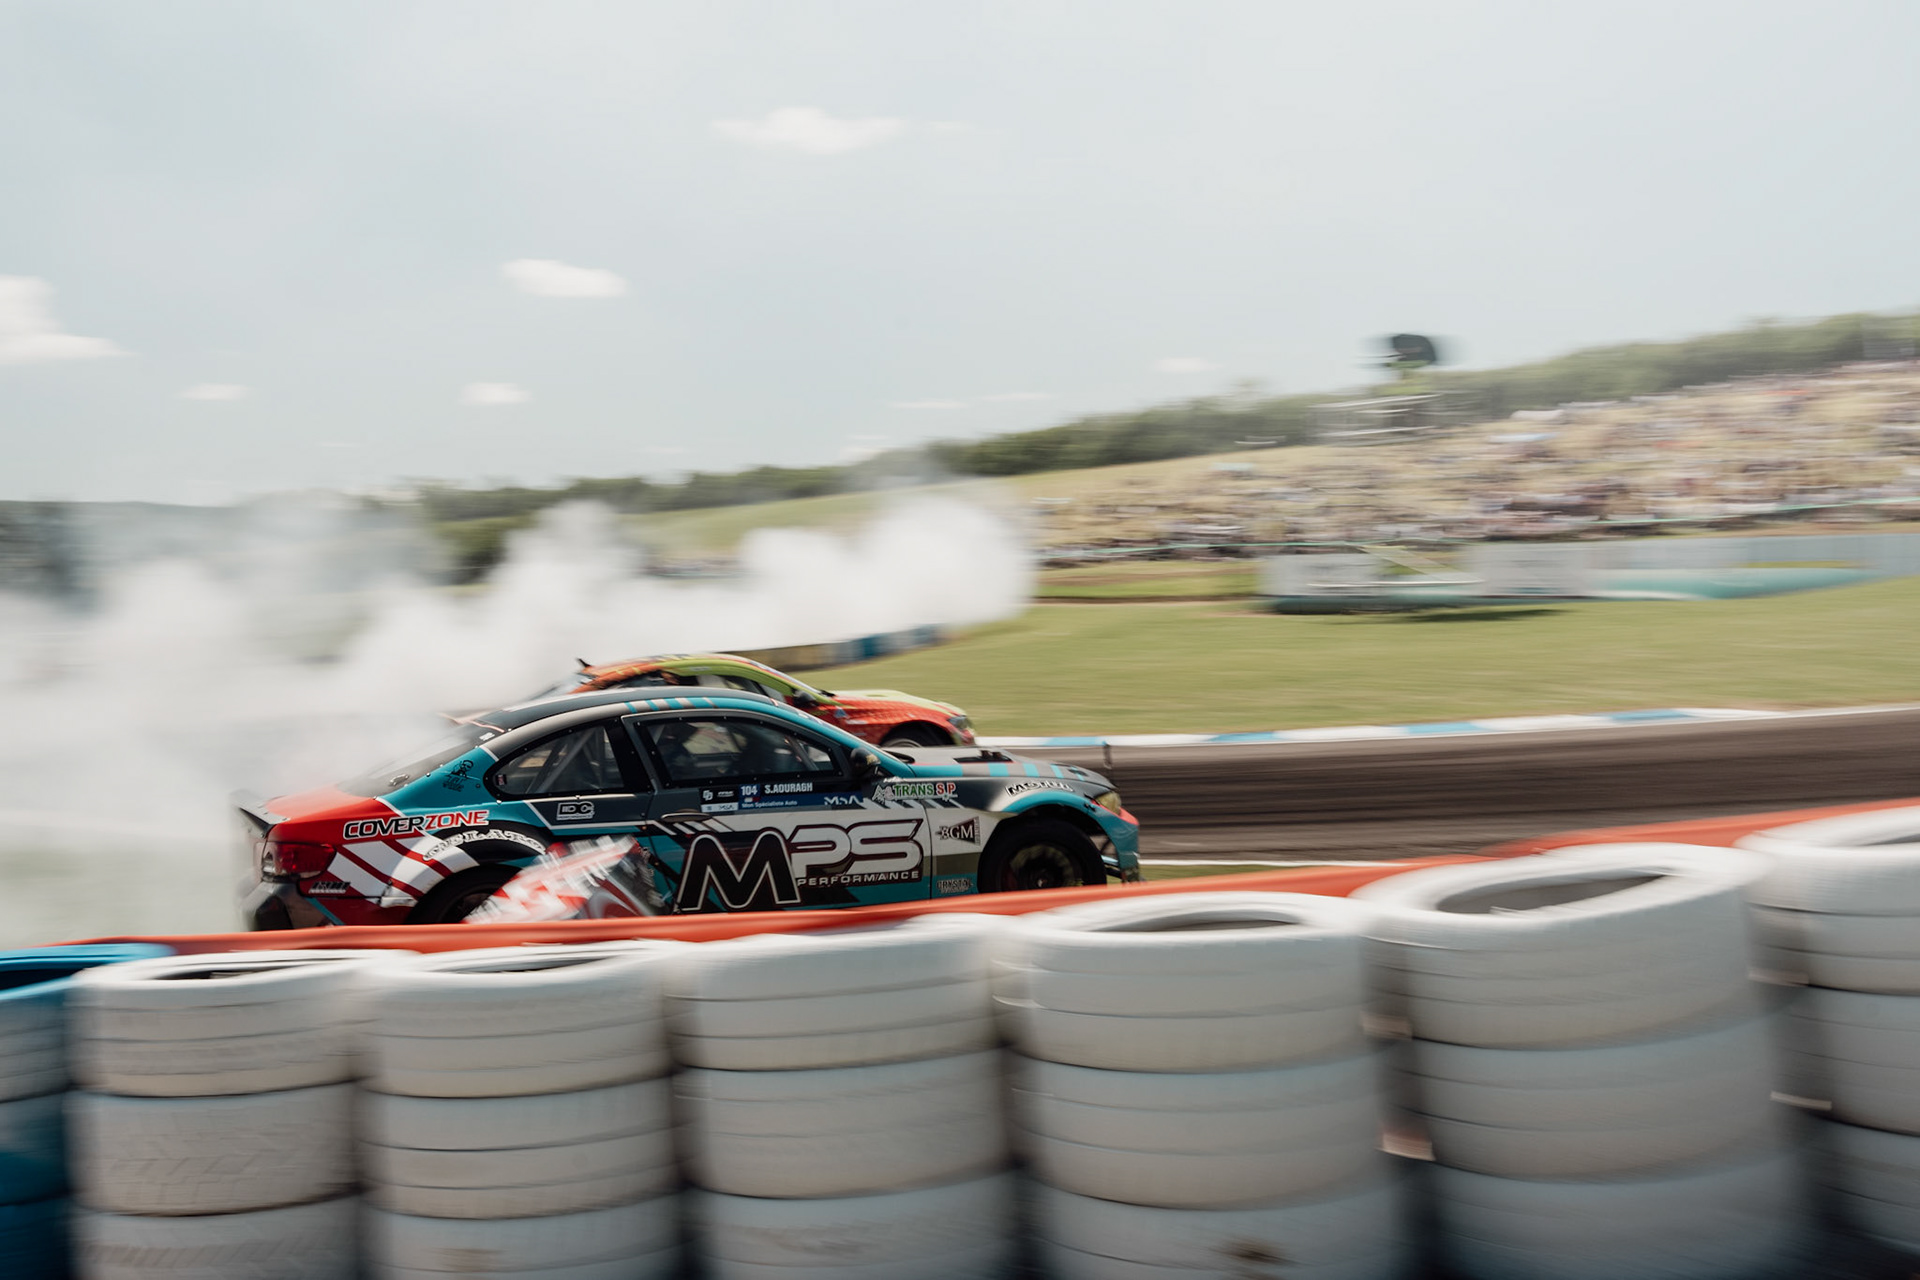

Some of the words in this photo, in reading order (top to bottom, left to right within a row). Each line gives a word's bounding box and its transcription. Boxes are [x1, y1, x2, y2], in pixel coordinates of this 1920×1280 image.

[741, 785, 758, 797] 104
[894, 783, 935, 797] TRANS
[343, 810, 489, 839] COVERZONE
[674, 818, 924, 912] MPS
[797, 870, 920, 887] PERFORMANCE
